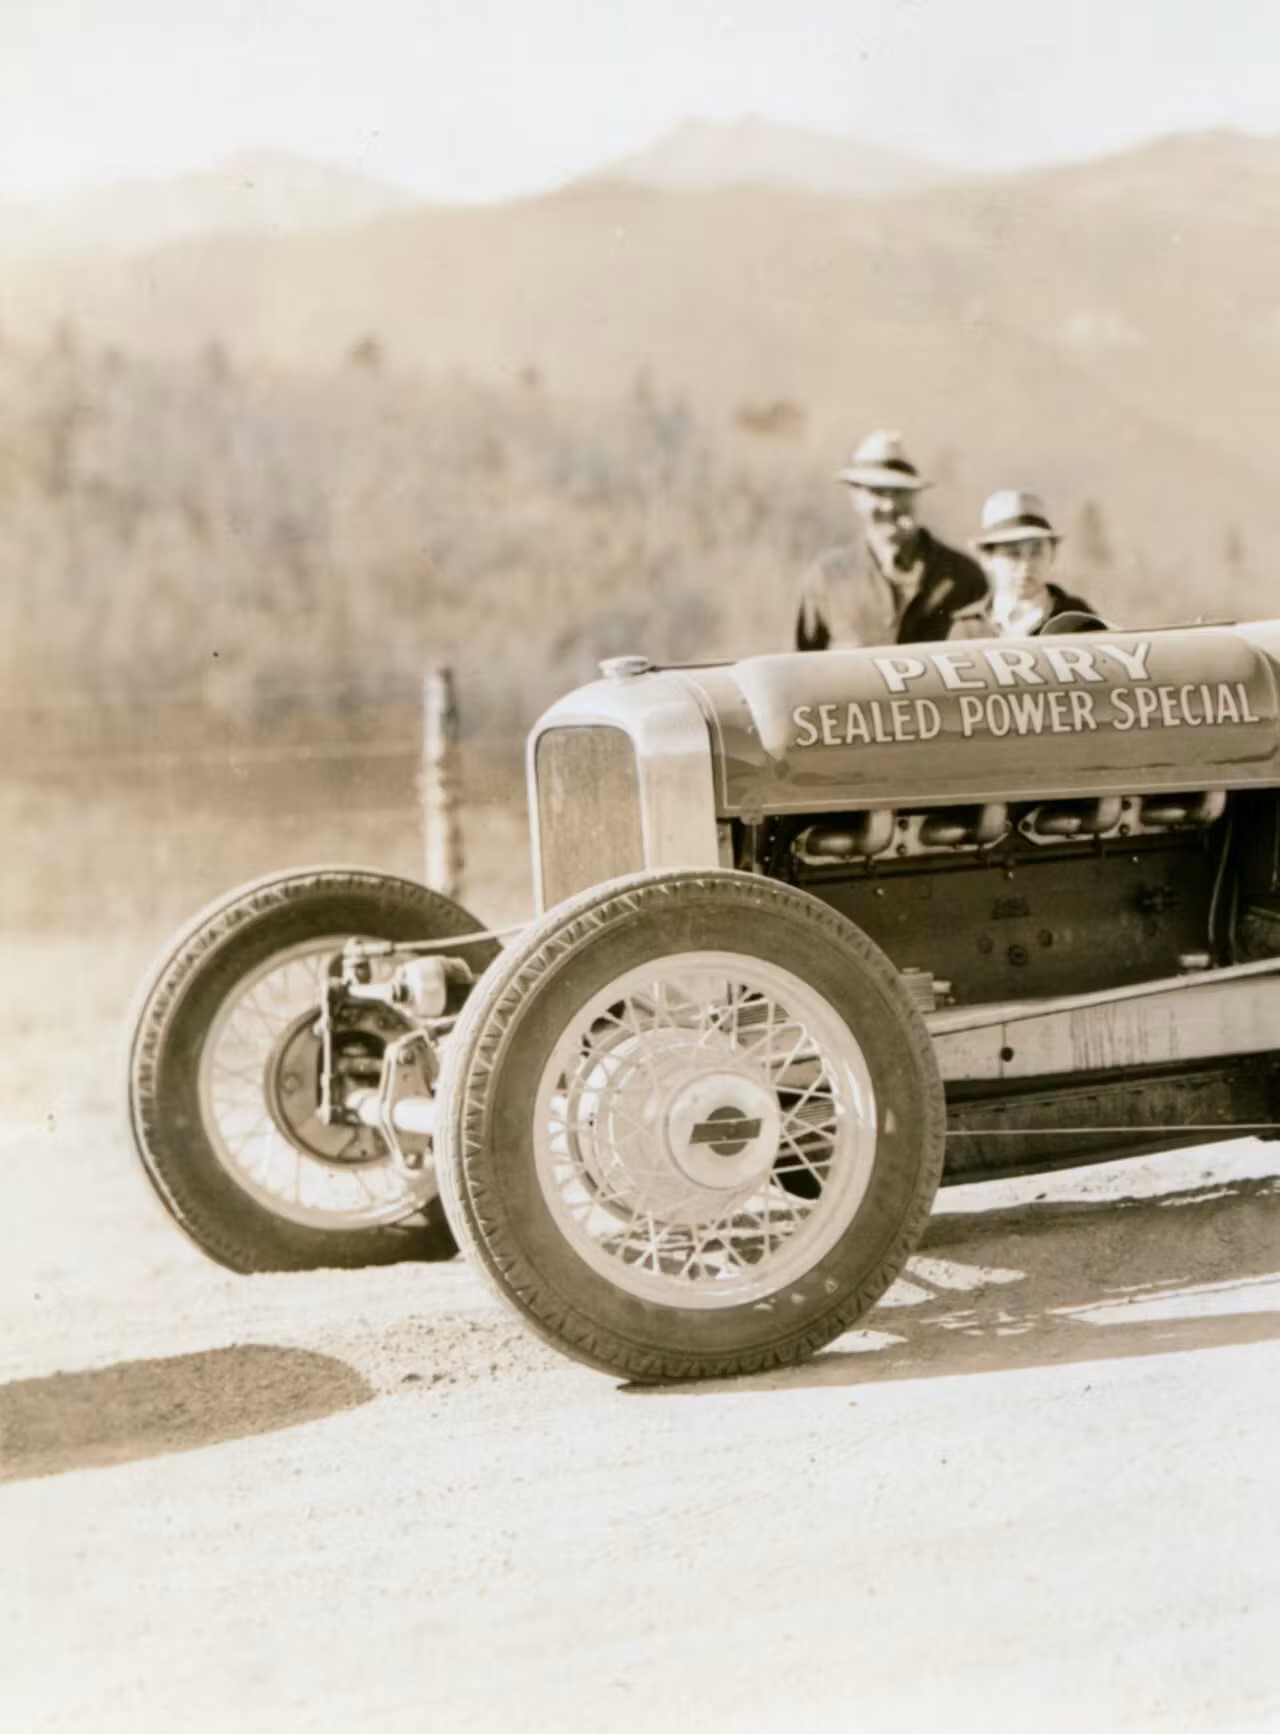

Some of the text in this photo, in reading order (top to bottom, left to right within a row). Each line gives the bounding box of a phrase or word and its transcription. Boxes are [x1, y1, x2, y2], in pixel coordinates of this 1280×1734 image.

[873, 641, 1151, 692] PERRY
[794, 683, 1260, 746] SEALED POWER SPECIAL
